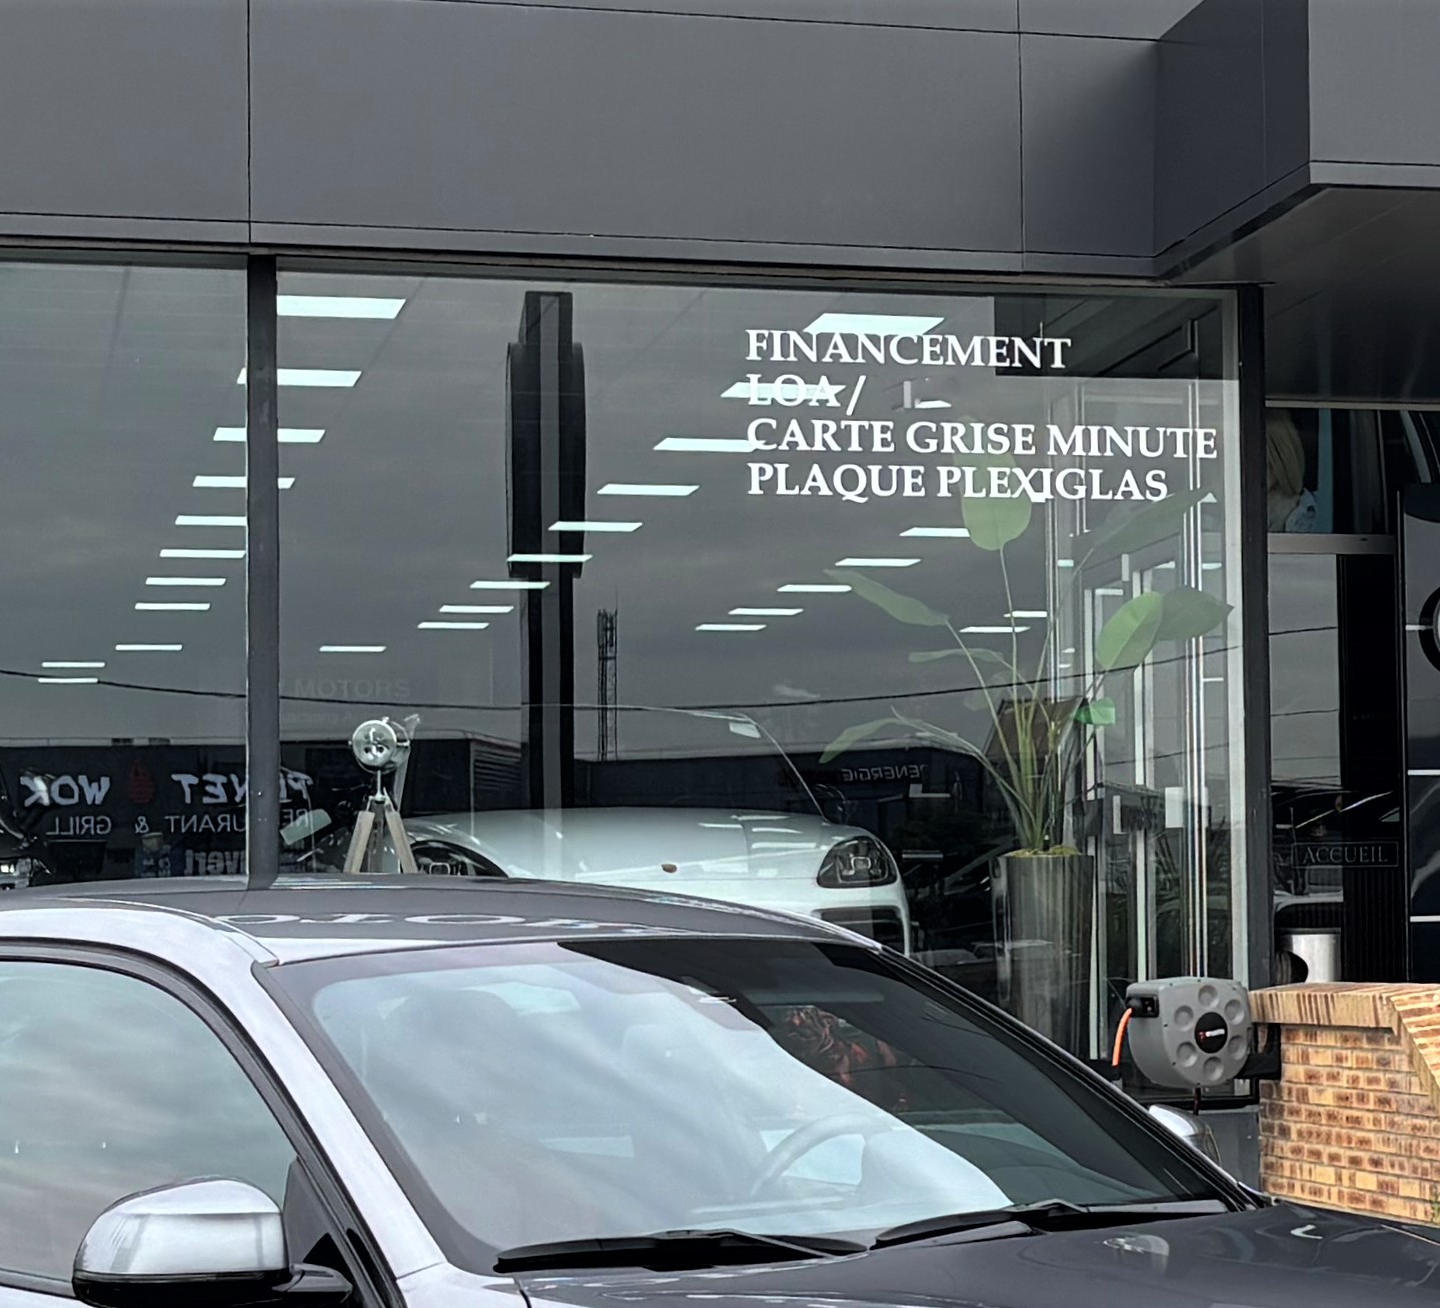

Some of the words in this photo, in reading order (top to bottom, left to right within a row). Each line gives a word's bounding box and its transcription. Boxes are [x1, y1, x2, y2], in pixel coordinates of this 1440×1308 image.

[745, 328, 1072, 369] FINANCEMENT
[746, 417, 895, 452] CARTE
[905, 421, 1036, 455] GRISE
[1046, 424, 1218, 459] MINUTE
[746, 462, 926, 504] PLAQUE
[935, 465, 1168, 501] PLEXIGLAS
[1301, 845, 1389, 866] ACCUEIL
